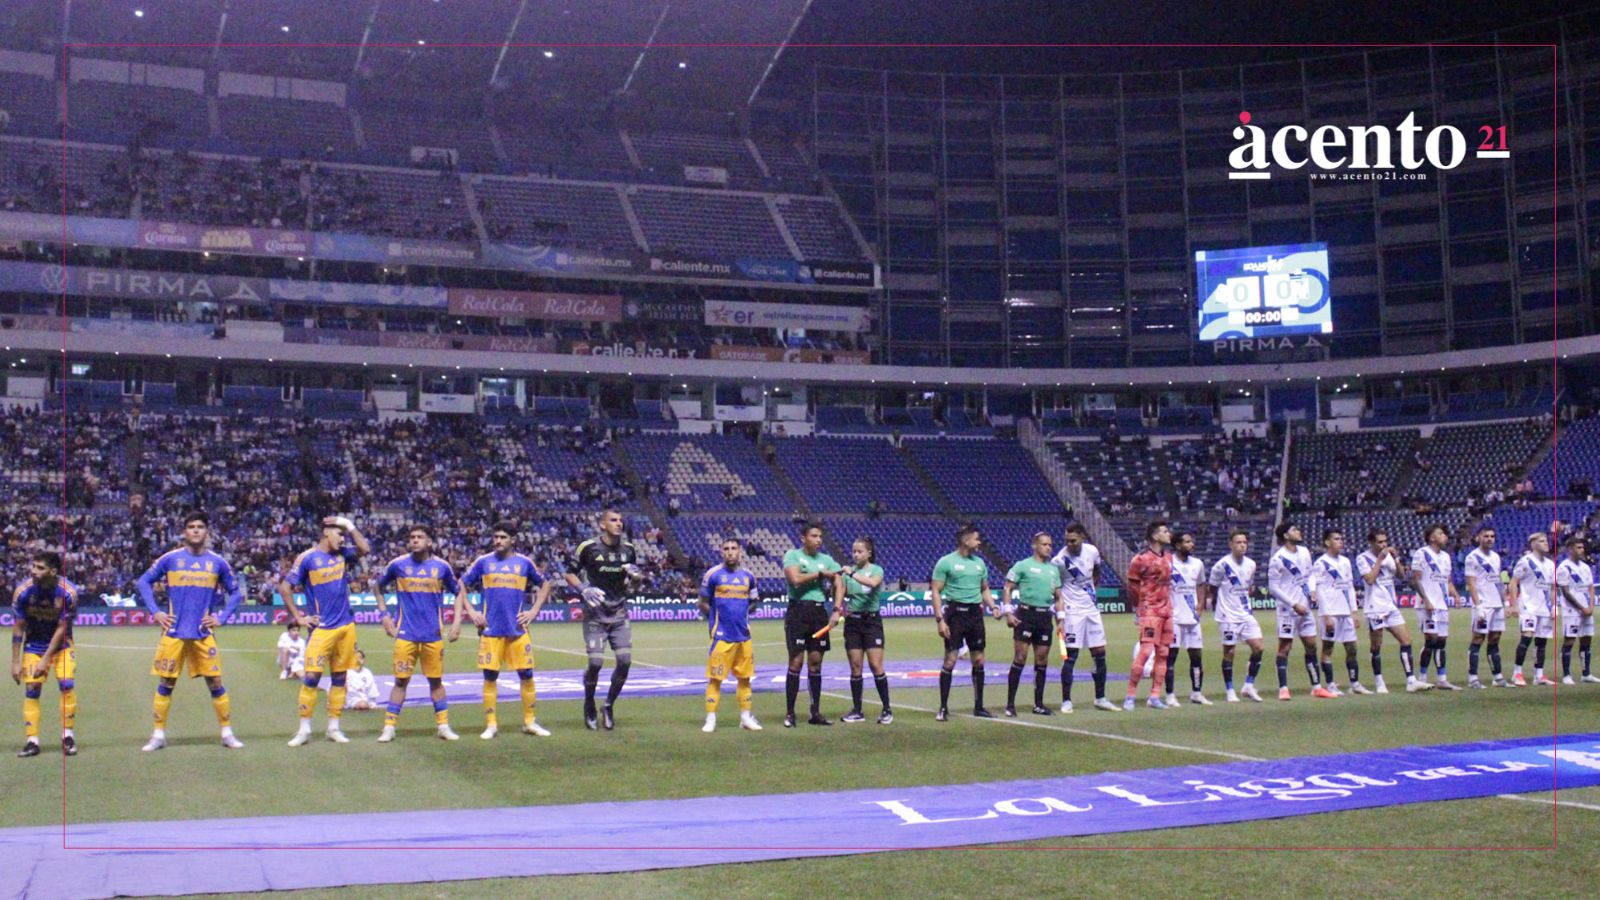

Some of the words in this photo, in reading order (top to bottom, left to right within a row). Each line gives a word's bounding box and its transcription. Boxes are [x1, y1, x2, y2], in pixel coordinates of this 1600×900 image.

[402, 246, 475, 260] caliente.mx
[568, 255, 632, 269] caliente.mx
[663, 259, 731, 274] caliente.mx
[86, 272, 213, 298] PIRMA
[1233, 283, 1249, 303] 0
[1276, 280, 1292, 300] 0
[734, 310, 755, 324] er
[1245, 311, 1281, 323] 00:00
[1213, 337, 1295, 353] PIRMA
[627, 605, 701, 621] aliente.mx
[868, 796, 1093, 826] La
[1092, 770, 1397, 807] Liga
